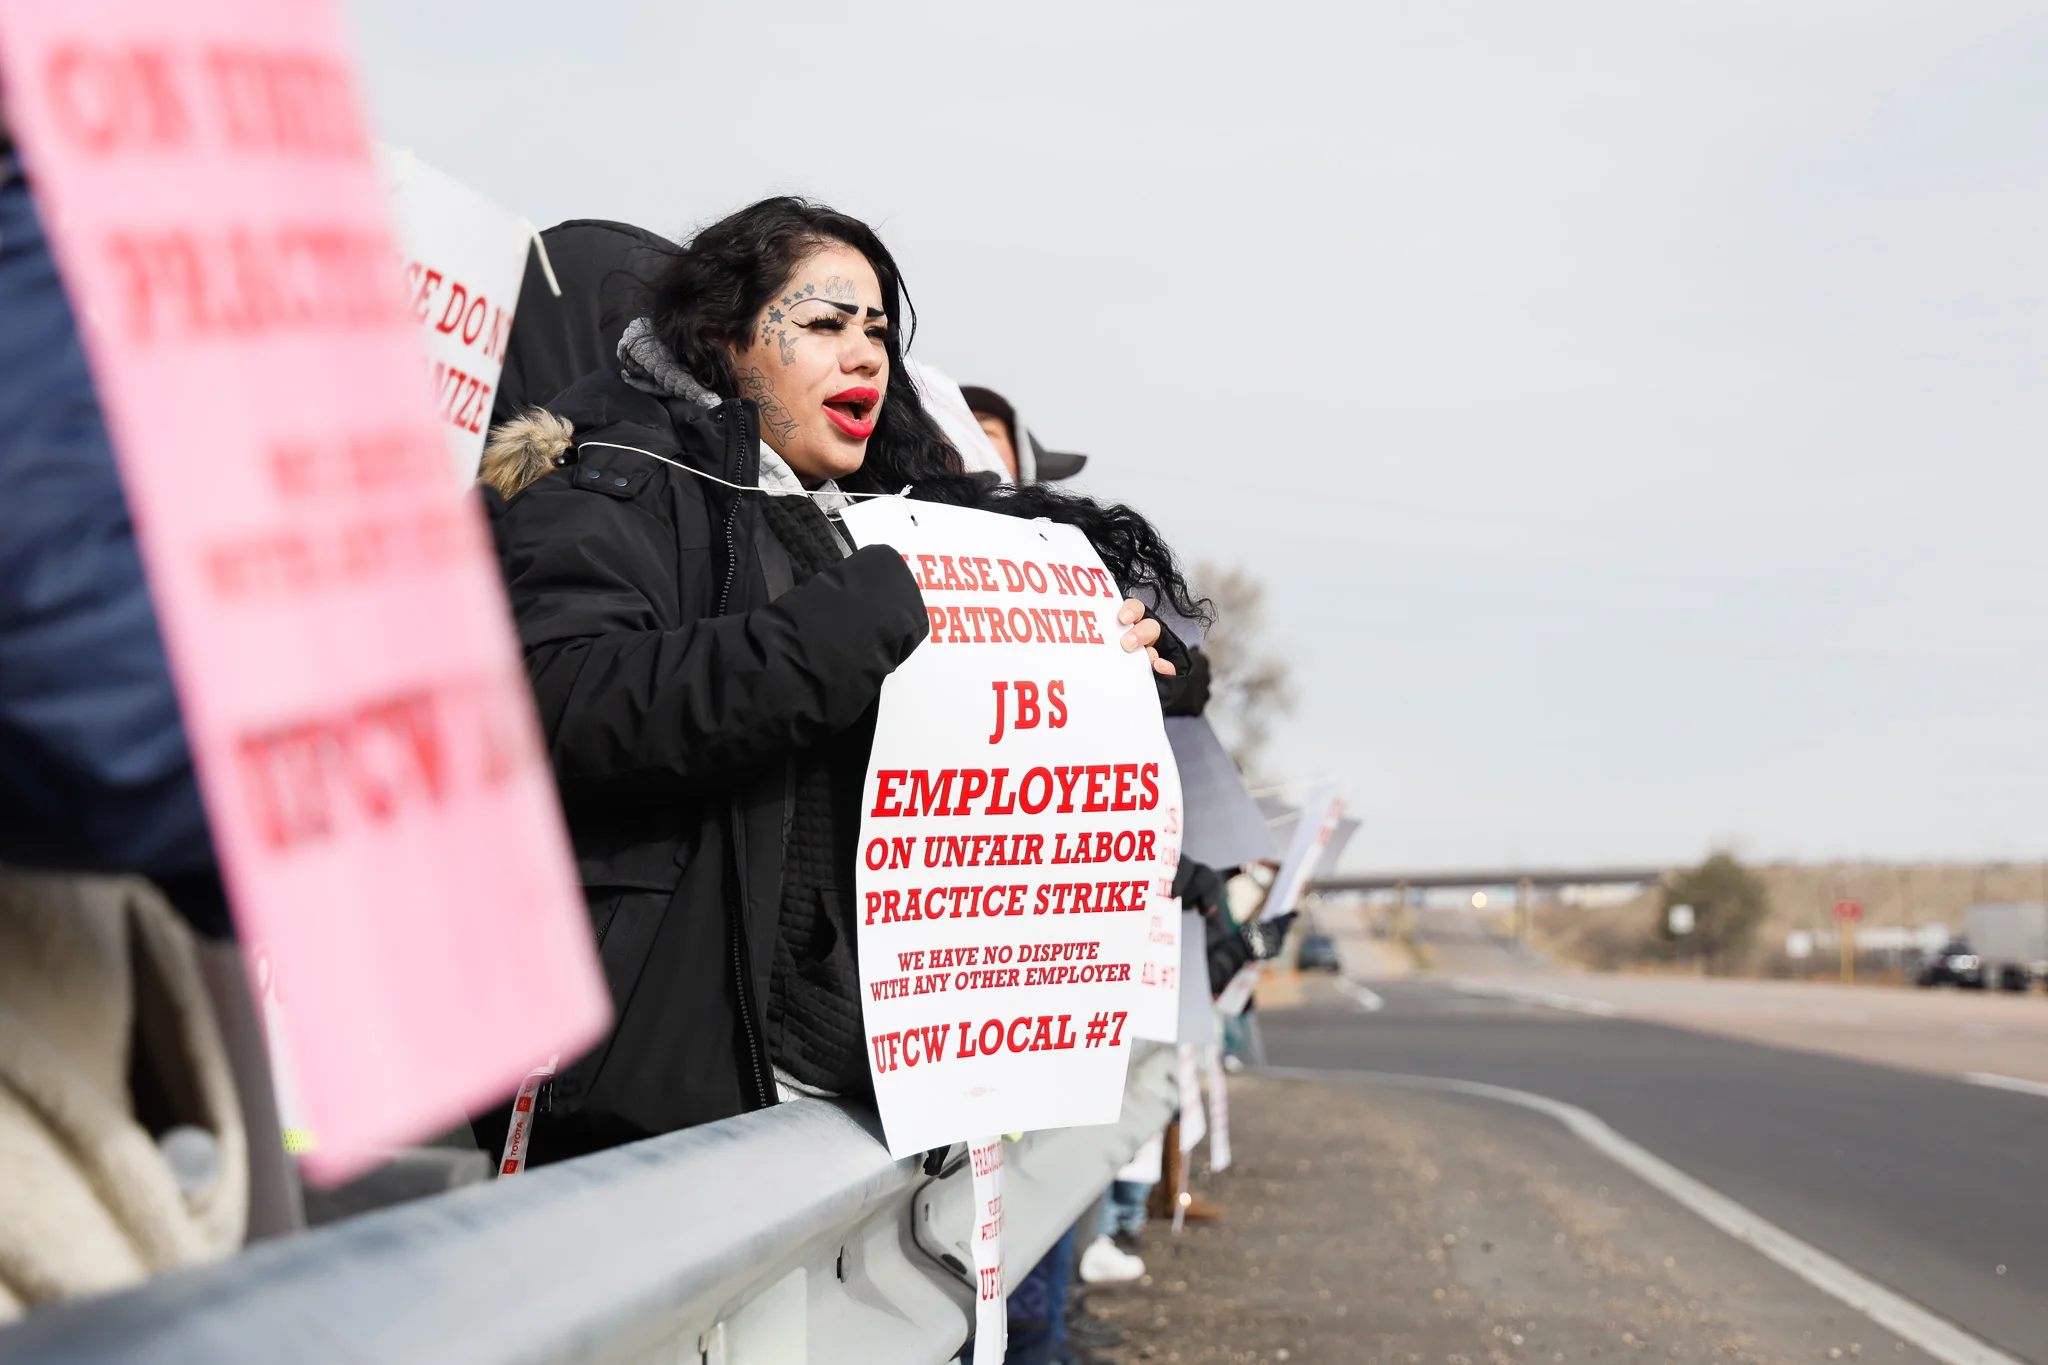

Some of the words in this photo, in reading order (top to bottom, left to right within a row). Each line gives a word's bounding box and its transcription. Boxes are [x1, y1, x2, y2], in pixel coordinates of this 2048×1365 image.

[435, 281, 487, 346] DO
[997, 558, 1048, 594] DO
[1047, 563, 1114, 599] NOT
[926, 606, 1105, 645] PATRONIZE
[989, 679, 1068, 745] JBS
[870, 762, 1160, 818] EMPLOYEES
[865, 835, 917, 872] ON
[923, 833, 1045, 868] UNFAIR
[1050, 829, 1157, 865] LABOR
[865, 884, 1029, 926] PRACTICE
[1032, 879, 1150, 916] STRIKE
[897, 950, 926, 972] WE
[928, 946, 980, 970] HAVE
[982, 944, 1014, 965] NO
[1016, 941, 1101, 964] DISPUTE
[870, 977, 911, 1002] WITH
[913, 972, 952, 996] ANY
[954, 968, 1022, 991] OTHER
[1024, 963, 1131, 987] EMPLOYER
[871, 1023, 951, 1074] UFCW
[956, 1014, 1077, 1059] LOCAL
[1085, 1011, 1128, 1049] #7
[511, 1121, 524, 1157] TOYOTA
